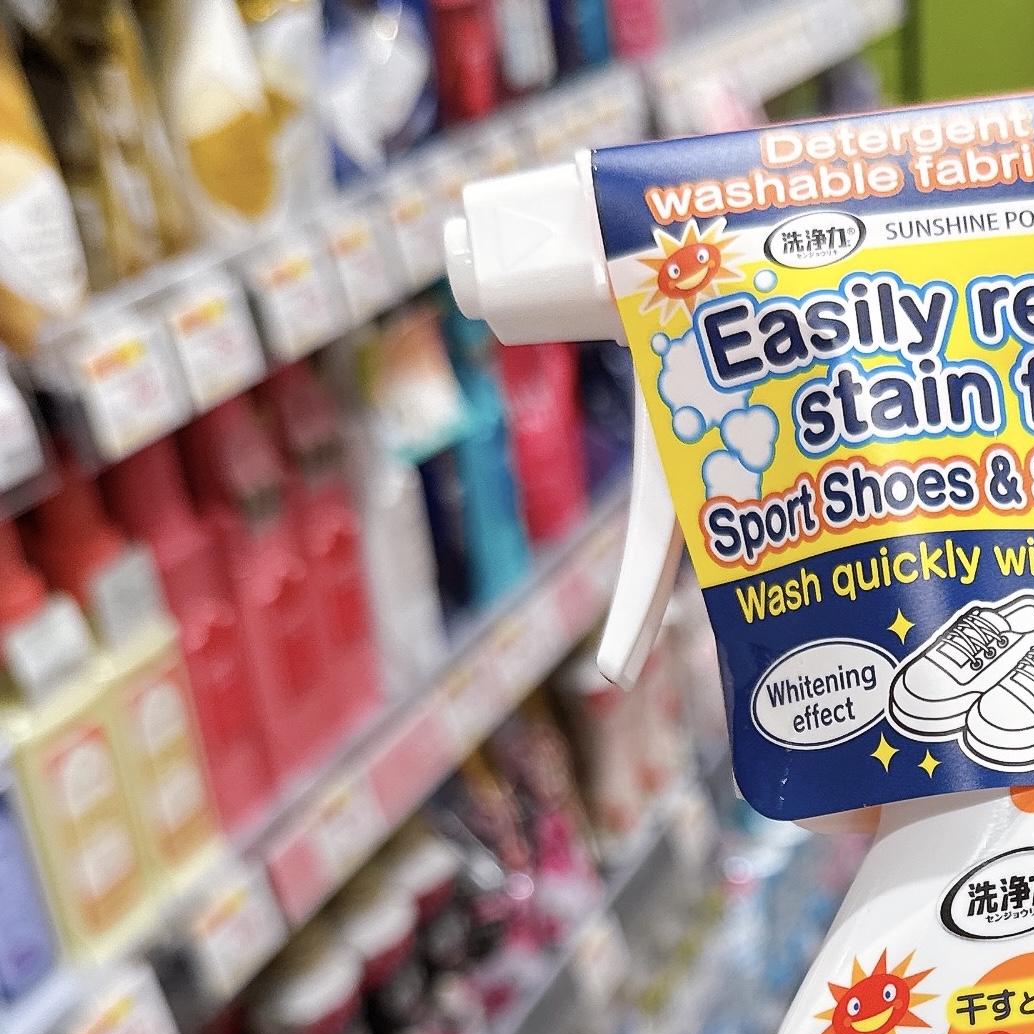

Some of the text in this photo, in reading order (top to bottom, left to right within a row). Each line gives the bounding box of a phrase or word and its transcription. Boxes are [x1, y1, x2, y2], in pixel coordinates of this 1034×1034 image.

[764, 101, 1029, 166] Detergent
[651, 161, 899, 221] washable
[885, 213, 999, 240] SUNSHINE
[703, 281, 947, 382] Easily
[799, 357, 996, 447] stain
[708, 483, 816, 561] Sport
[823, 466, 975, 523] Shoes
[989, 454, 1022, 504] &
[735, 567, 822, 624] Wash
[832, 538, 981, 601] quickly
[766, 662, 877, 709] Whitening
[792, 698, 856, 734] effect
